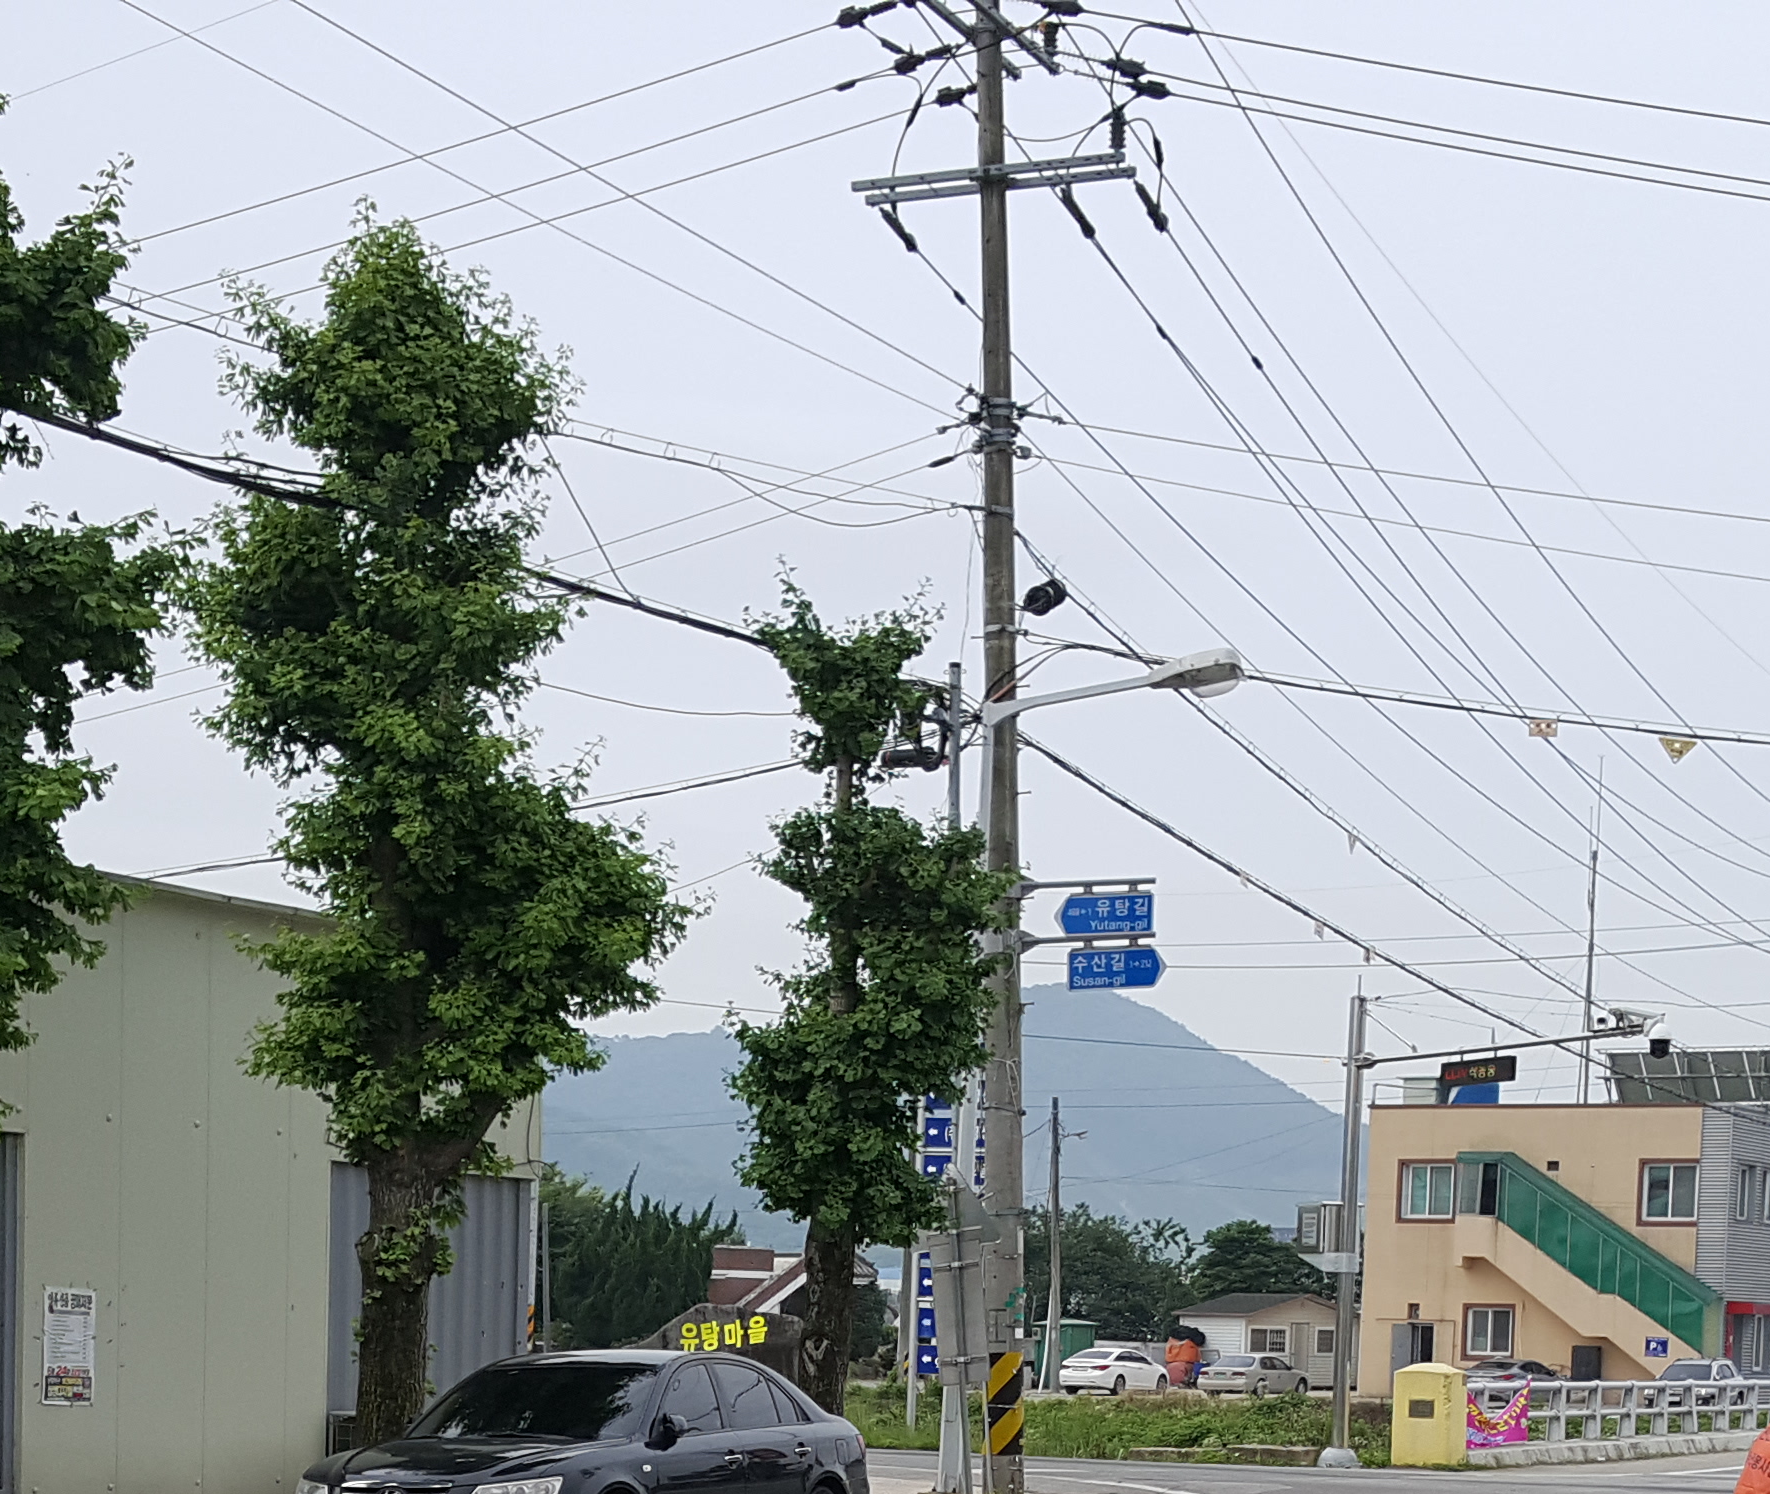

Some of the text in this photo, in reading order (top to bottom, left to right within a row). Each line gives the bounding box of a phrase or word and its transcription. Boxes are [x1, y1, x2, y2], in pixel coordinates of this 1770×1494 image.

[1095, 896, 1149, 918] 유탕길
[1089, 918, 1149, 931] Yutang-gil
[1072, 953, 1126, 974] 수산길
[1073, 974, 1126, 987] Susan-gil
[679, 1315, 769, 1353] 유탕마을
